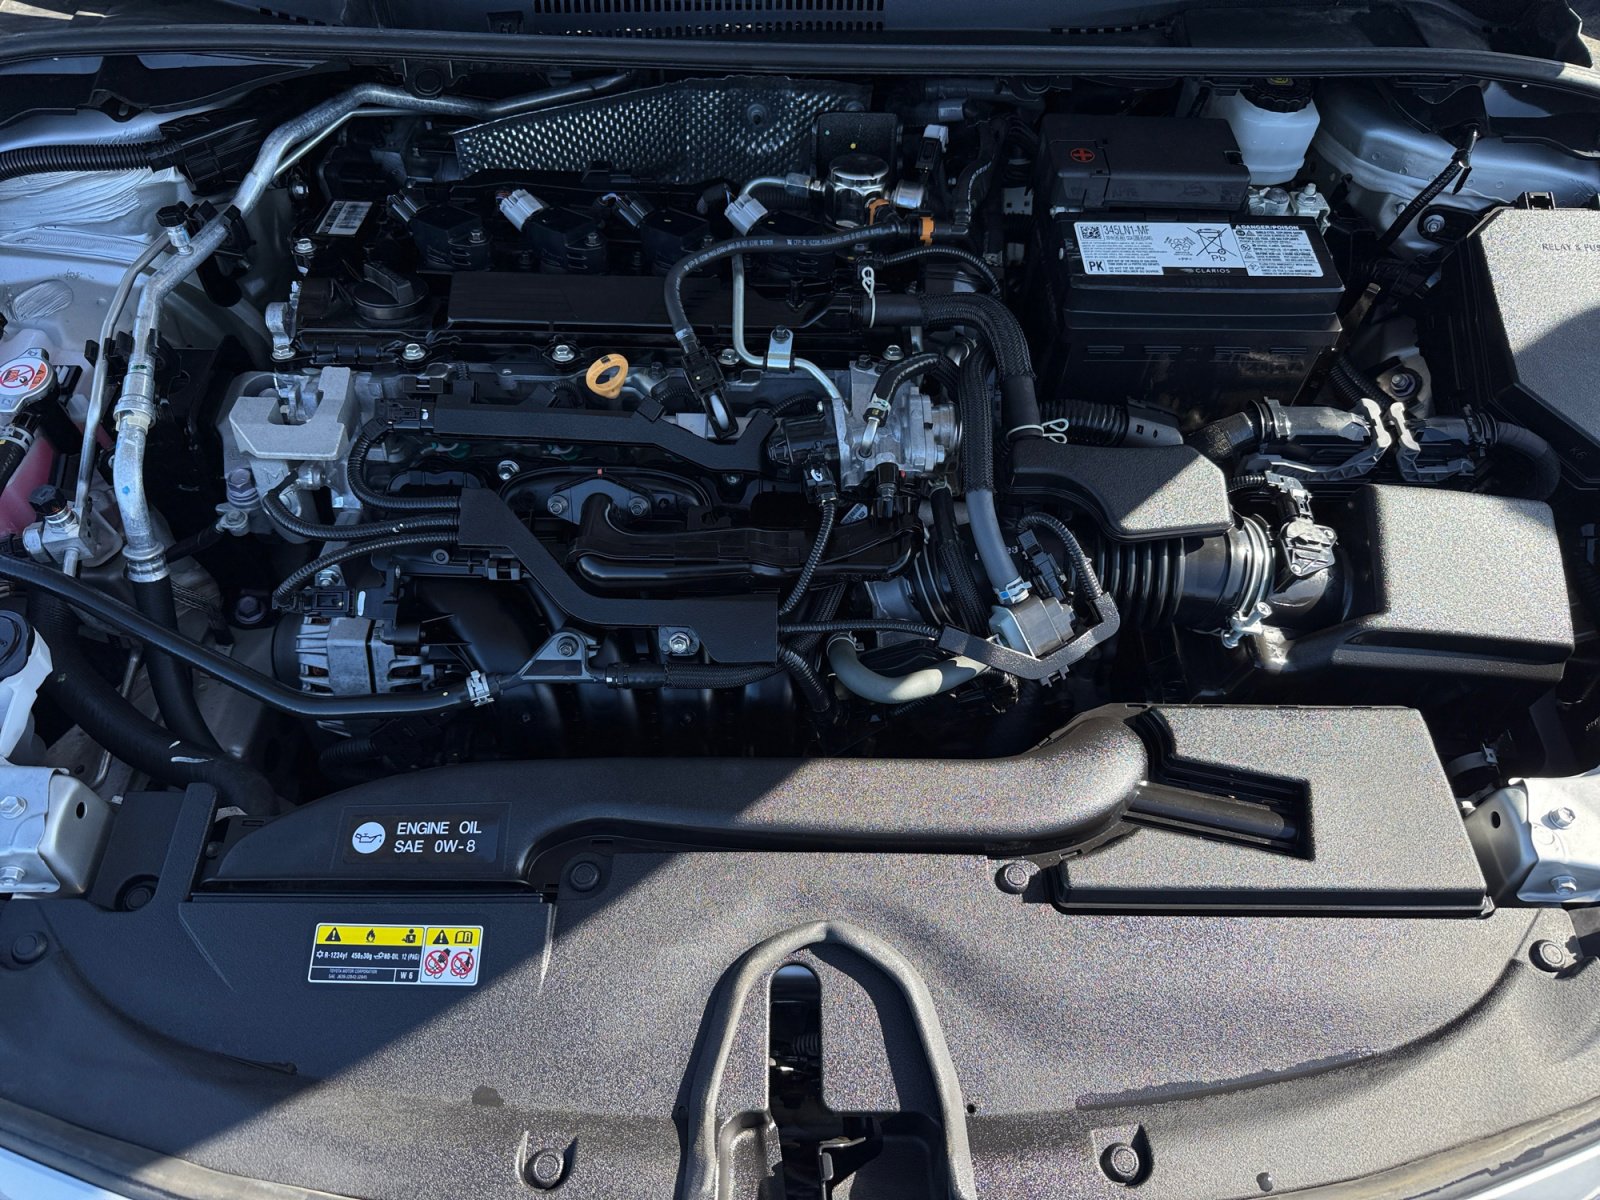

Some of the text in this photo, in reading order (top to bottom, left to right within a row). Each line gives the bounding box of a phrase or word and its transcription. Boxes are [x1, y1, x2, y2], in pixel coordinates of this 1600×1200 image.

[1103, 225, 1150, 236] 345LN1-MF
[1541, 243, 1571, 251] RELAY
[1211, 254, 1226, 262] Pb
[1088, 261, 1105, 272] PK
[397, 821, 482, 834] ENGINE OIL
[394, 840, 476, 852] SAE 0W-8
[324, 951, 348, 960] R-1234yf
[401, 953, 408, 961] 12
[400, 971, 407, 979] W
